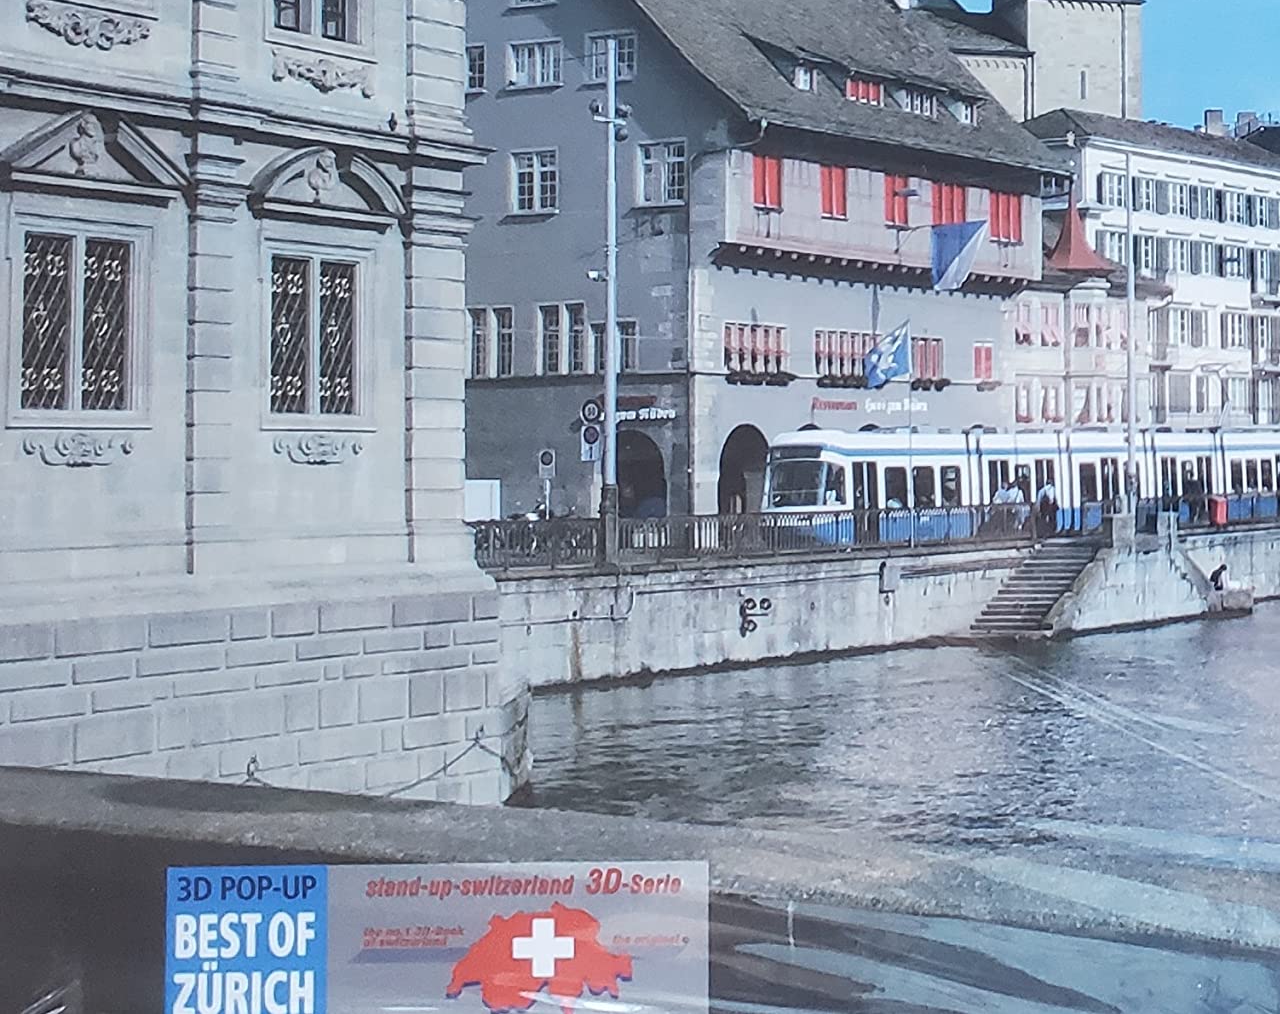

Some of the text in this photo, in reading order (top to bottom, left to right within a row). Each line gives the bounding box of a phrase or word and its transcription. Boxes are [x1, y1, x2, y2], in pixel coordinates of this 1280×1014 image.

[177, 874, 317, 901] 3D POP-UP
[174, 911, 316, 959] BEST OF
[172, 960, 315, 1014] ZÜRICH
